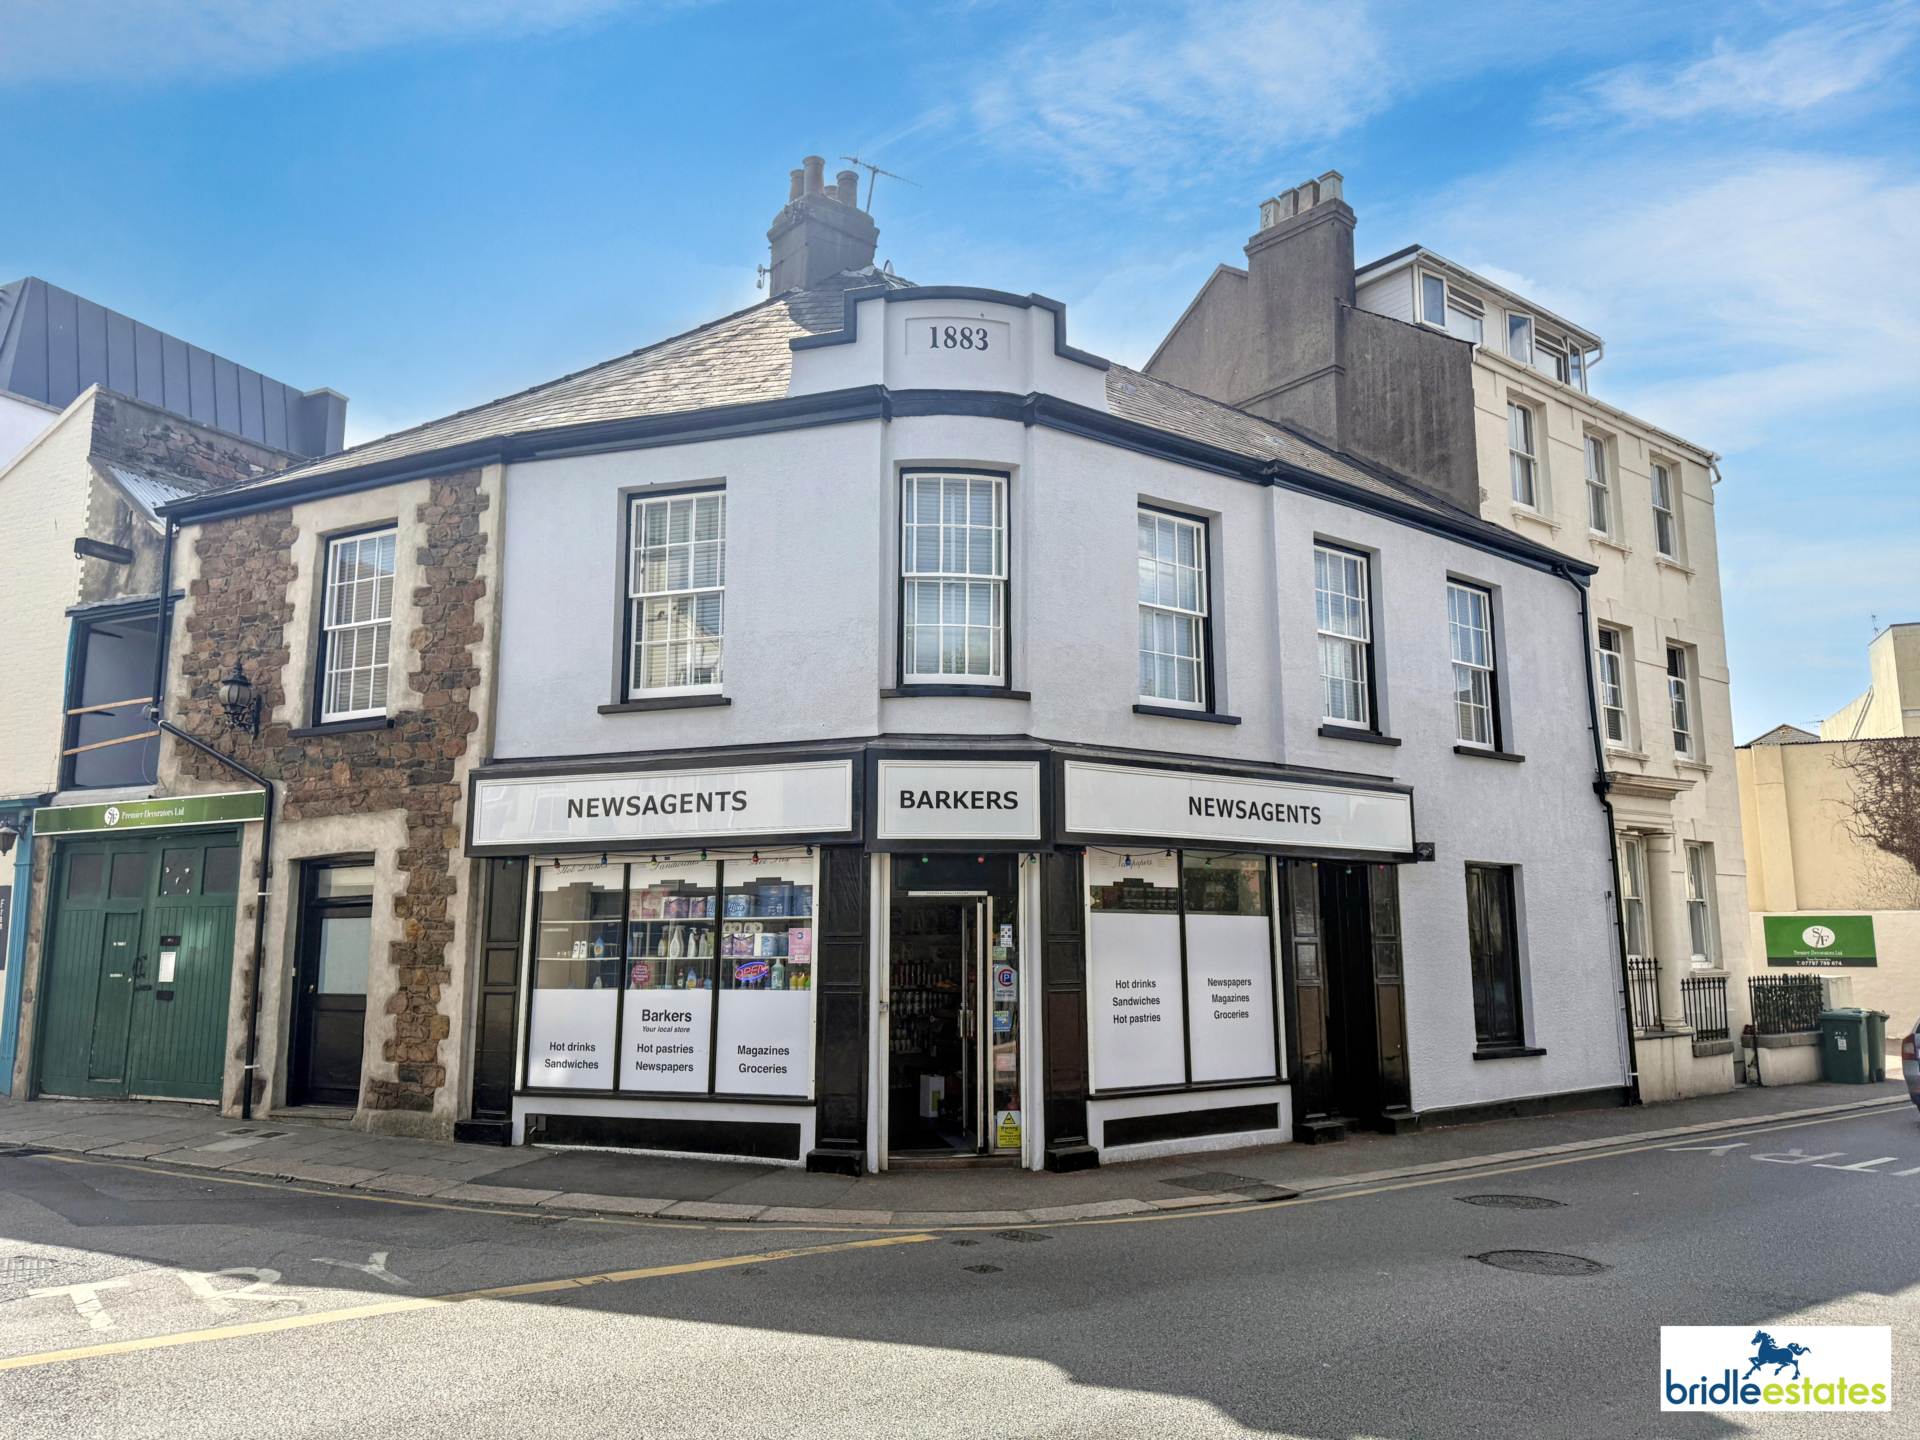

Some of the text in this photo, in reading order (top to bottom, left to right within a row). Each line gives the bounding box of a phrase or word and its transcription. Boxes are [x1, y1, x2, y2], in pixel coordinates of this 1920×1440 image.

[929, 325, 989, 351] 1883
[567, 790, 748, 819] NEWSAGENTS
[899, 790, 1019, 810] BARKERS
[1188, 796, 1322, 825] NEWSAGENTS
[735, 964, 769, 980] OPEN
[1115, 979, 1157, 989] Hot drinks
[1207, 977, 1252, 989] Newspapers
[1112, 996, 1161, 1007] Sandwiches
[1211, 993, 1250, 1005] Magazines
[641, 1008, 693, 1023] Barkers
[1113, 1012, 1161, 1026] Hot pastries
[1213, 1009, 1249, 1020] Groceries
[642, 1025, 691, 1034] Your local store
[549, 1041, 596, 1053] Hot drinks
[636, 1042, 695, 1056] Hot pastries
[737, 1044, 791, 1058] Magazines
[544, 1057, 599, 1070] Sandwiches
[635, 1060, 694, 1074] Newspapers
[738, 1062, 788, 1074] Groceries
